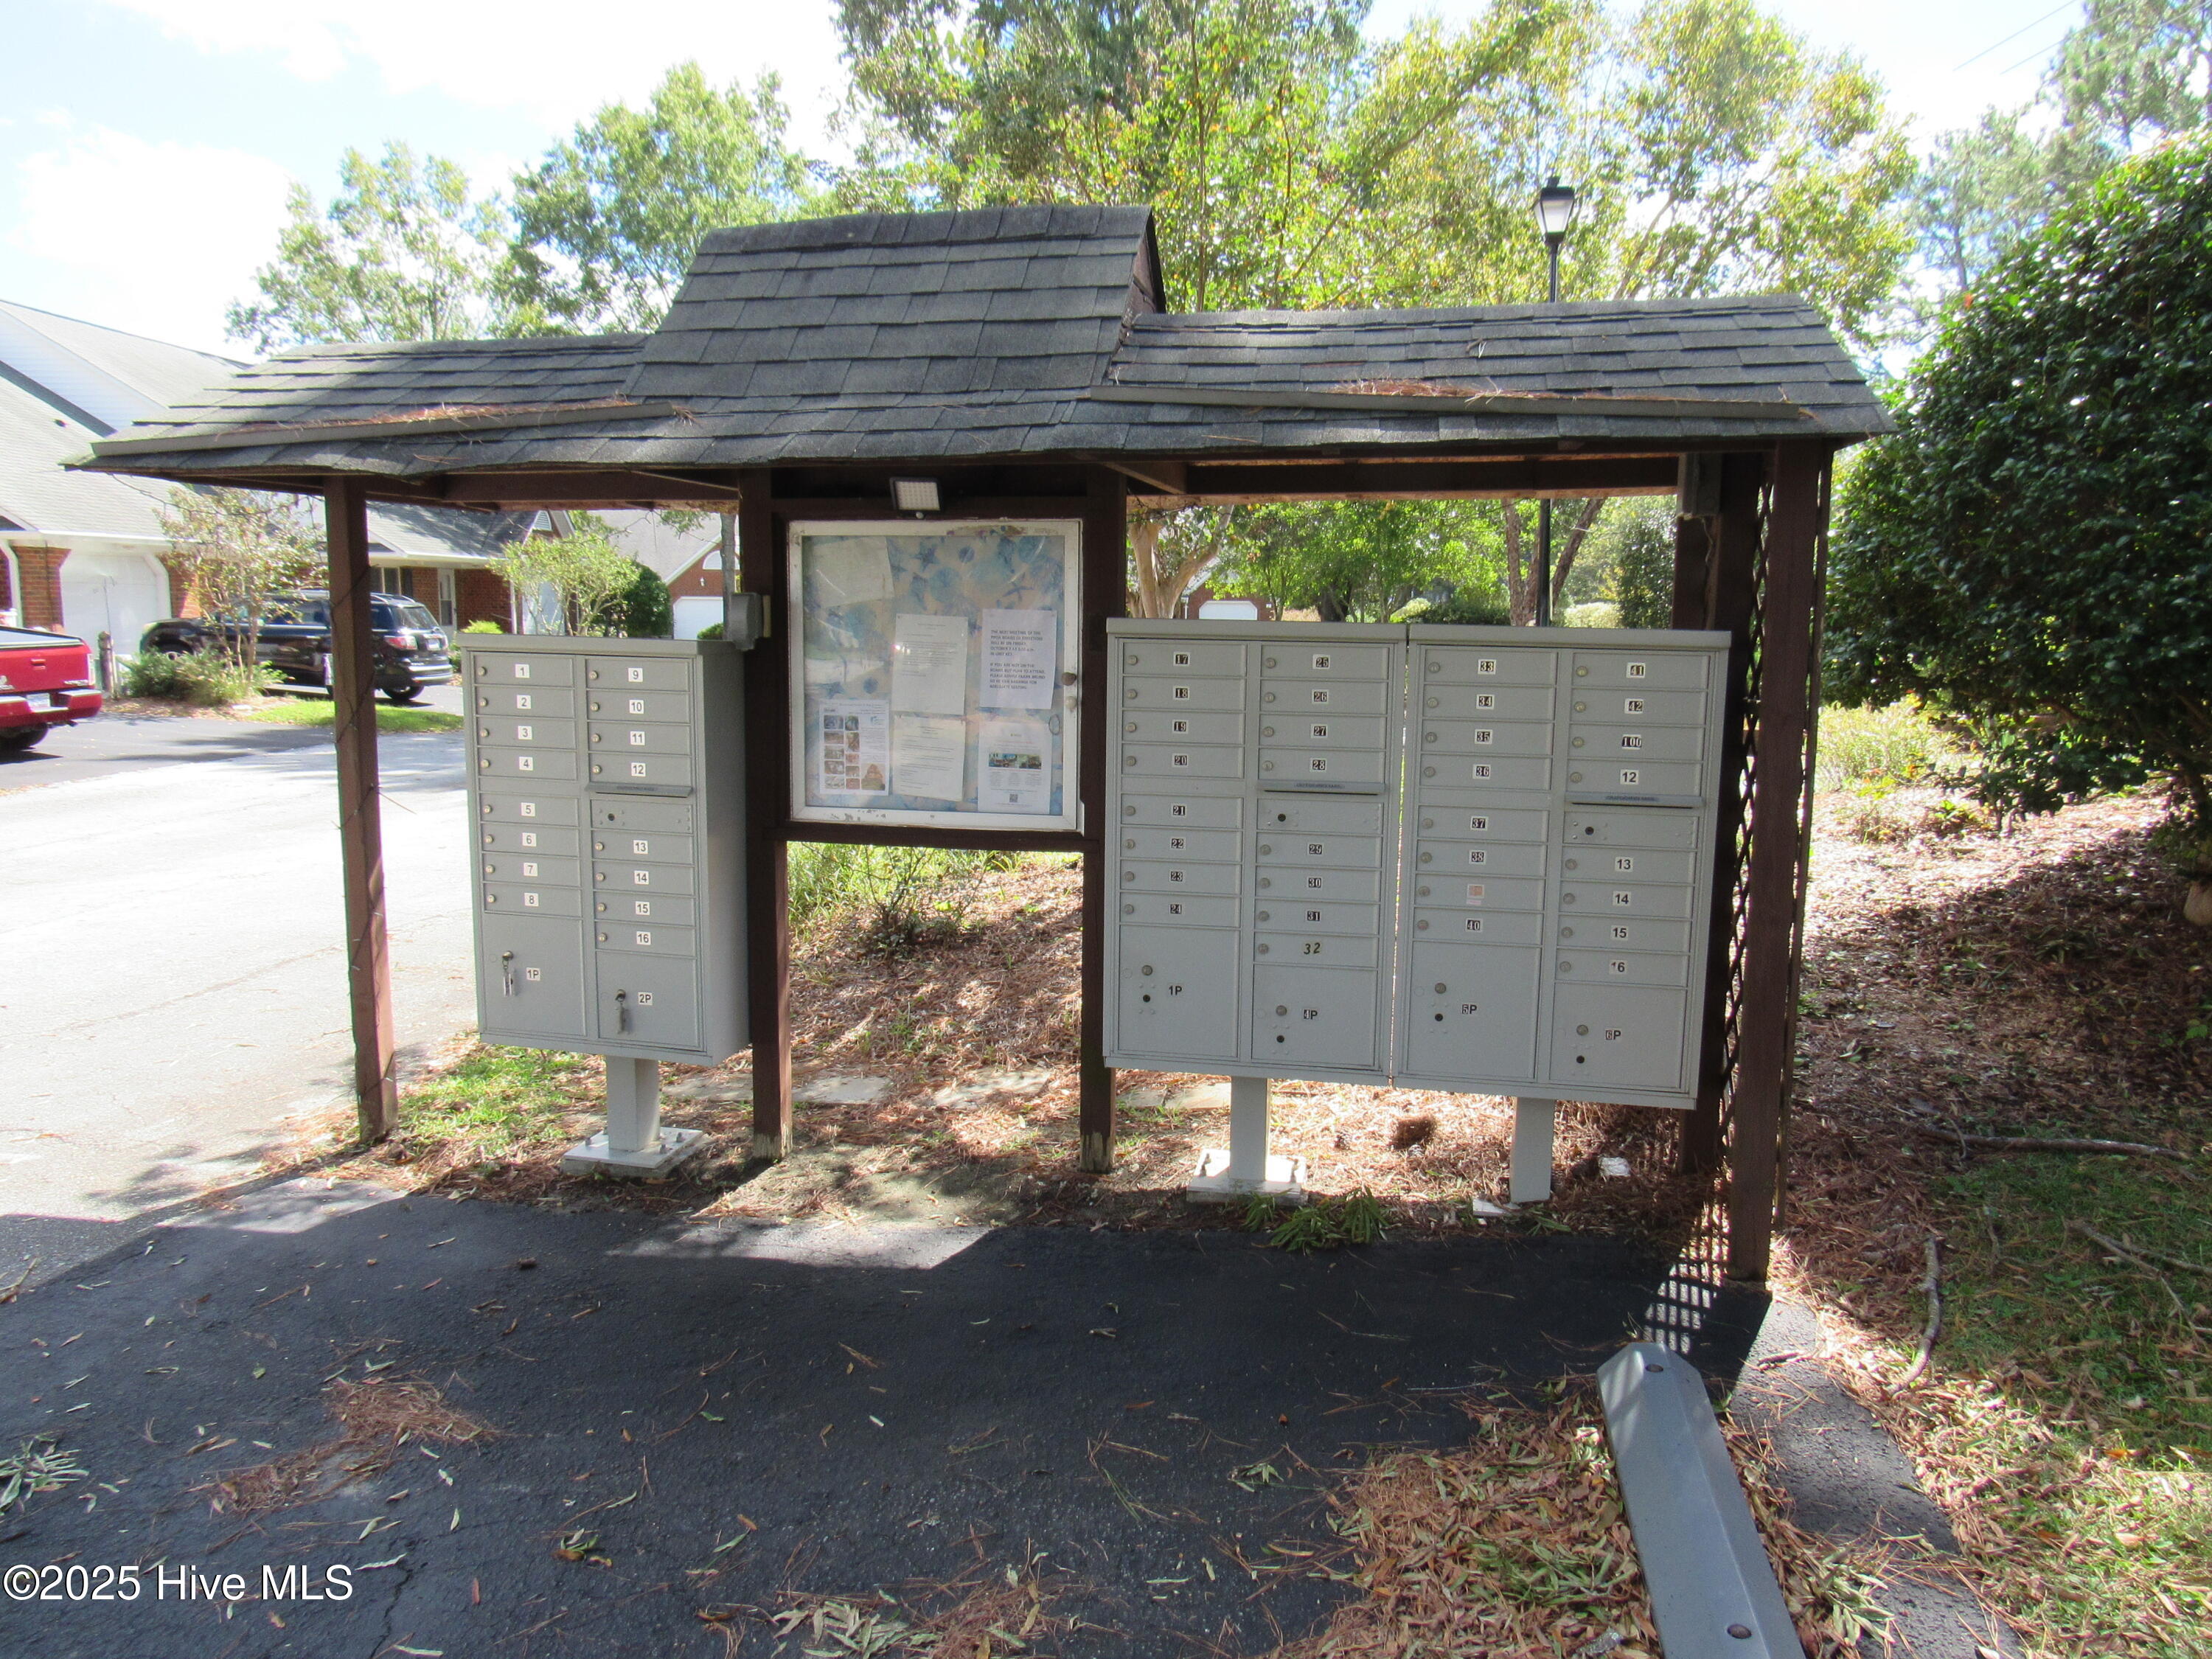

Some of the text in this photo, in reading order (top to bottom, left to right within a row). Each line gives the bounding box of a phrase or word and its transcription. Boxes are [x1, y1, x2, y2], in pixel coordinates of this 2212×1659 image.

[1176, 655, 1188, 665] 17
[1315, 657, 1329, 667] 25
[521, 667, 525, 675] 1
[1480, 661, 1493, 672] 33
[1630, 665, 1644, 675] 41
[633, 670, 639, 680] 9
[1175, 688, 1188, 699] 18
[1314, 692, 1326, 702] 26
[521, 698, 527, 706] 2
[1478, 696, 1492, 707] 34
[1629, 700, 1643, 712] 42
[632, 702, 642, 712] 10
[1174, 721, 1186, 732] 19
[1314, 726, 1326, 737] 27
[522, 728, 528, 737] 3
[1477, 731, 1490, 742] 35
[633, 734, 642, 743] 11
[1622, 737, 1642, 748] 100
[524, 759, 529, 768] 4
[1175, 755, 1187, 765] 20
[633, 765, 644, 775] 12
[1312, 760, 1326, 771] 28
[1476, 766, 1489, 777] 36
[1622, 772, 1637, 782] 12
[525, 805, 532, 814] 5
[1173, 806, 1186, 816] 21
[1472, 818, 1486, 829] 37
[526, 835, 532, 844] 6
[1172, 839, 1183, 849] 22
[636, 843, 647, 852] 13
[1310, 844, 1322, 855] 29
[1472, 852, 1485, 863] 38
[528, 865, 533, 874] 7
[1617, 860, 1631, 869] 13
[636, 873, 647, 882] 14
[1171, 872, 1183, 882] 23
[1309, 878, 1321, 888] 30
[529, 895, 535, 905] 8
[1615, 894, 1629, 904] 14
[637, 904, 648, 913] 15
[1171, 904, 1181, 914] 24
[1307, 911, 1320, 921] 31
[1467, 920, 1481, 931] 40
[1613, 928, 1627, 938] 15
[638, 934, 649, 943] 16
[1304, 942, 1321, 954] 32
[528, 970, 539, 978] 1P
[1169, 986, 1182, 995] 1P
[640, 994, 651, 1003] 2P
[1304, 1009, 1318, 1020] 4P
[1462, 1004, 1477, 1015] 5P
